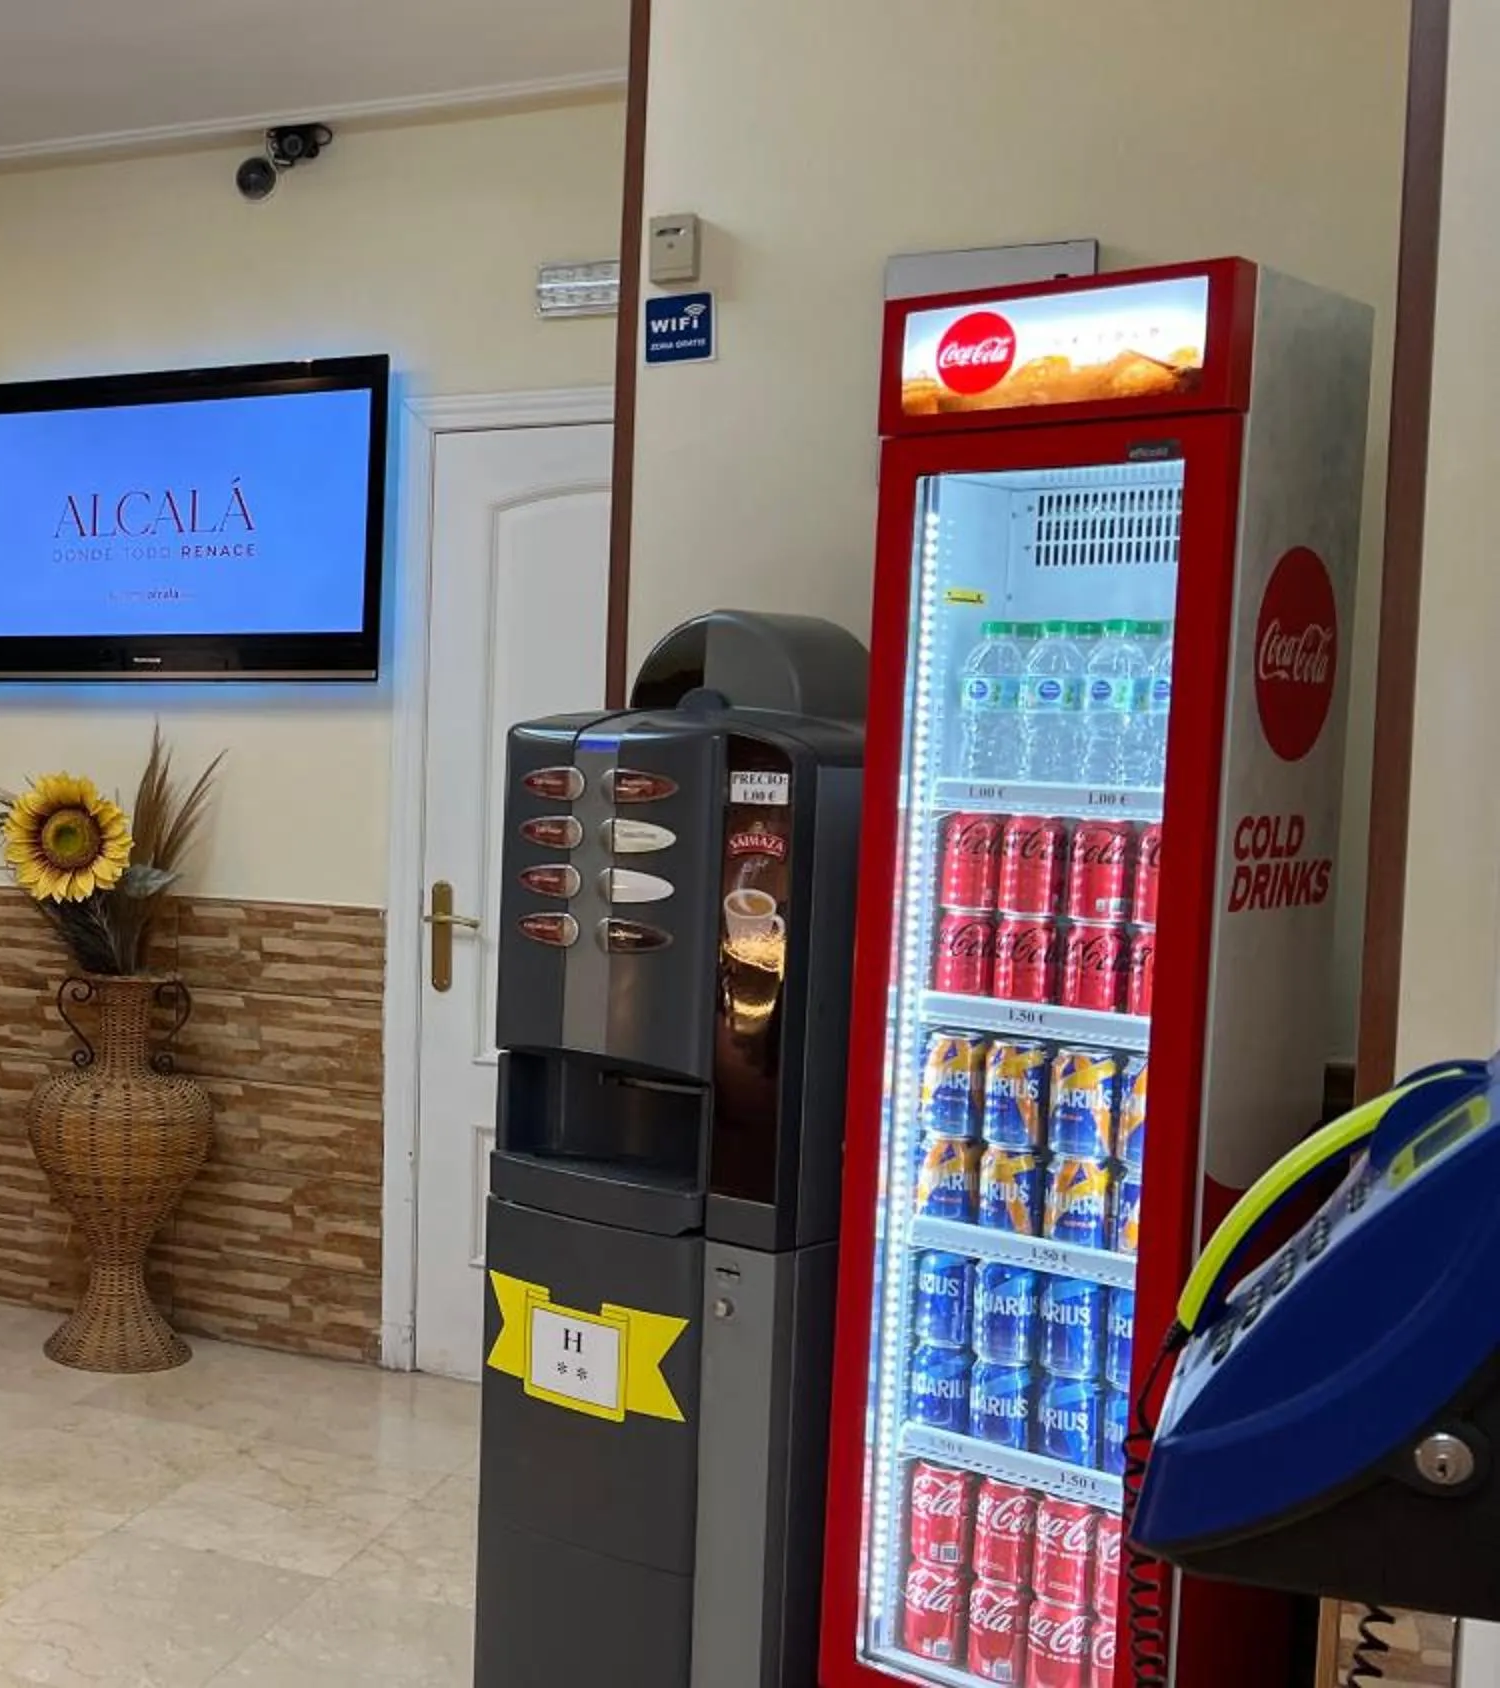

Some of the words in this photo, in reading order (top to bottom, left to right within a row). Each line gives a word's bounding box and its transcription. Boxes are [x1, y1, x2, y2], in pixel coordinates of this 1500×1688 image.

[938, 336, 1014, 368] Coca-Cola
[53, 476, 256, 539] ALCALÁ
[52, 546, 114, 563] DONDE
[125, 545, 172, 561] TODO
[180, 542, 257, 559] RENACE
[1258, 618, 1334, 684] Coca-Cola
[1233, 814, 1306, 862] COLD
[1227, 858, 1333, 914] DRINKS
[563, 1328, 583, 1353] H
